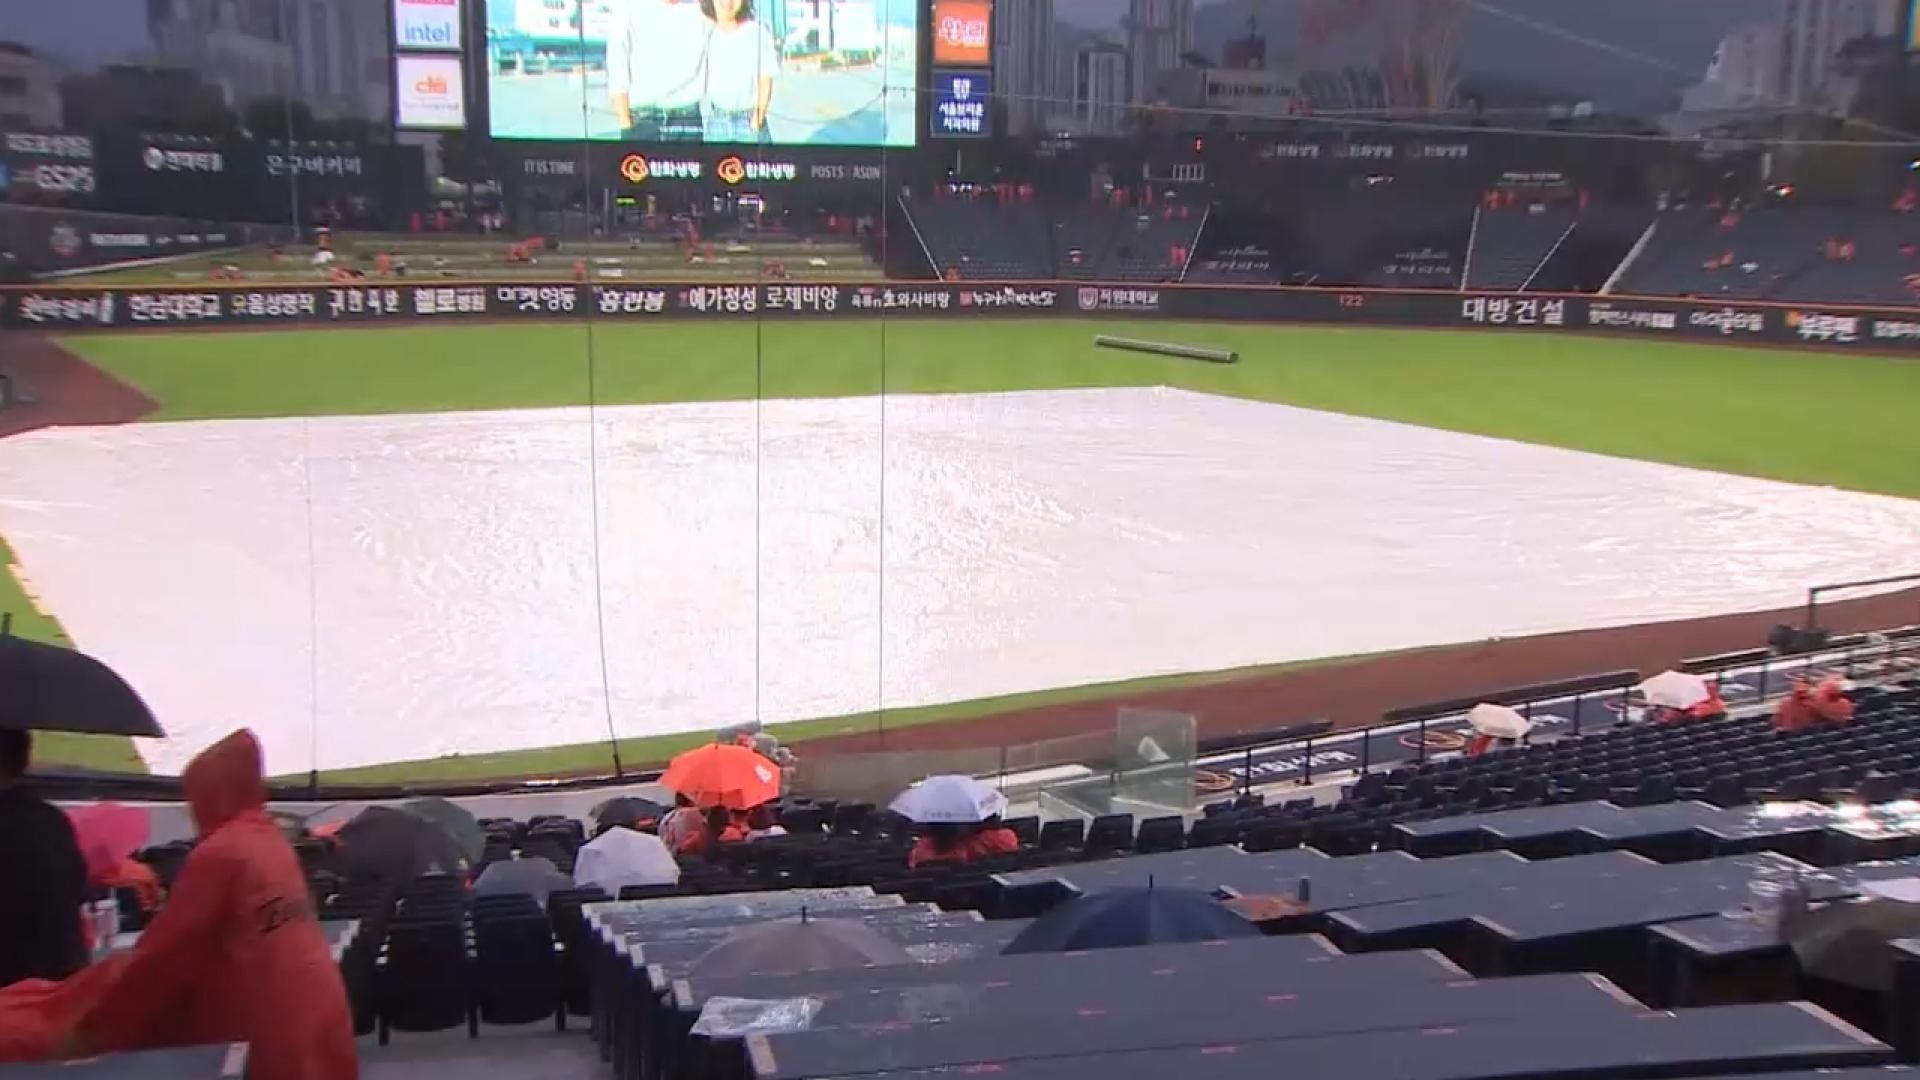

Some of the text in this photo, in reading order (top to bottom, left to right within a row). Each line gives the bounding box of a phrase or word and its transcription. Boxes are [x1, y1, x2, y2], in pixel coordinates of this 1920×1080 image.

[405, 21, 450, 42] intel
[689, 286, 757, 312] 예가정성
[766, 285, 838, 312] 로제비앙
[1340, 294, 1364, 307] 122
[1462, 296, 1564, 325] 대방건설
